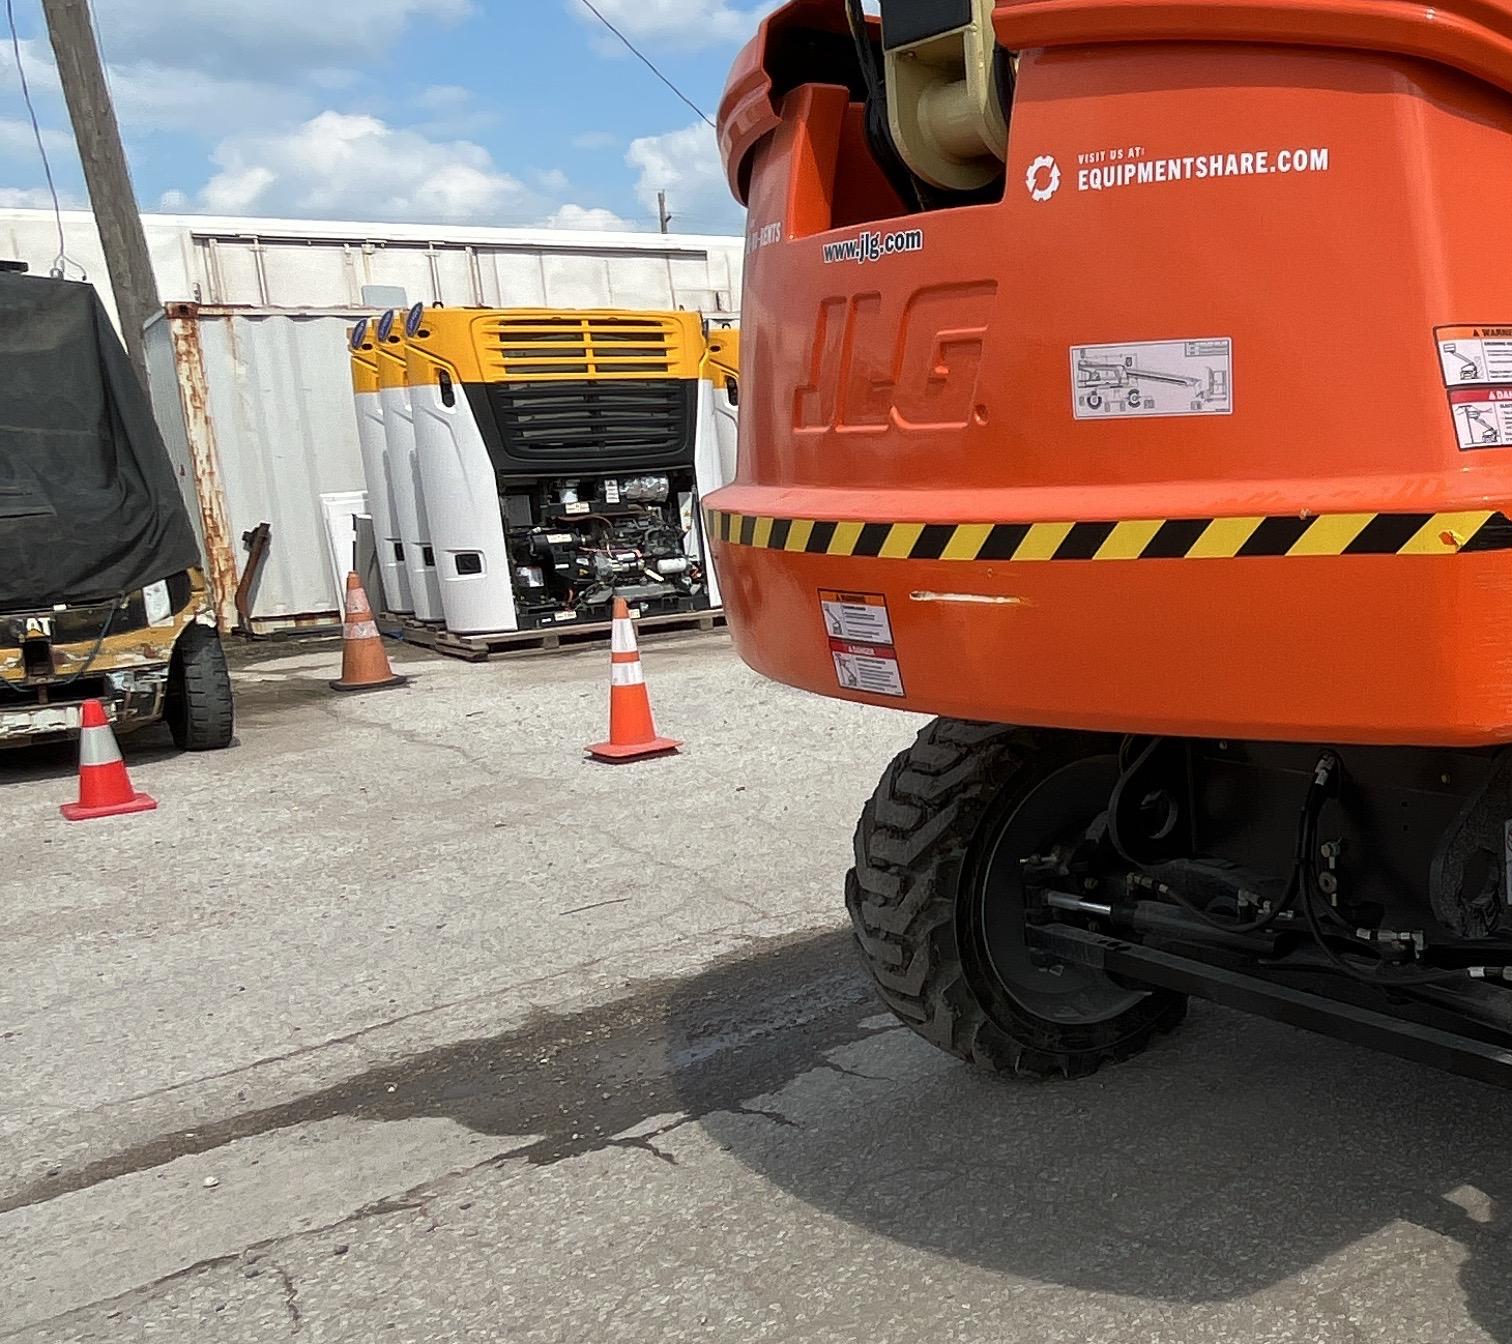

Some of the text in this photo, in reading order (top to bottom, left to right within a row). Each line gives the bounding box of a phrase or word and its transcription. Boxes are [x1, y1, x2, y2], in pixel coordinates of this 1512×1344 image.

[1078, 151, 1105, 164] VISIT
[1109, 149, 1124, 160] US
[1078, 148, 1329, 191] EQUIPMENTSHARE.COM
[823, 229, 922, 264] www.jlg.com
[794, 279, 998, 433] JLG
